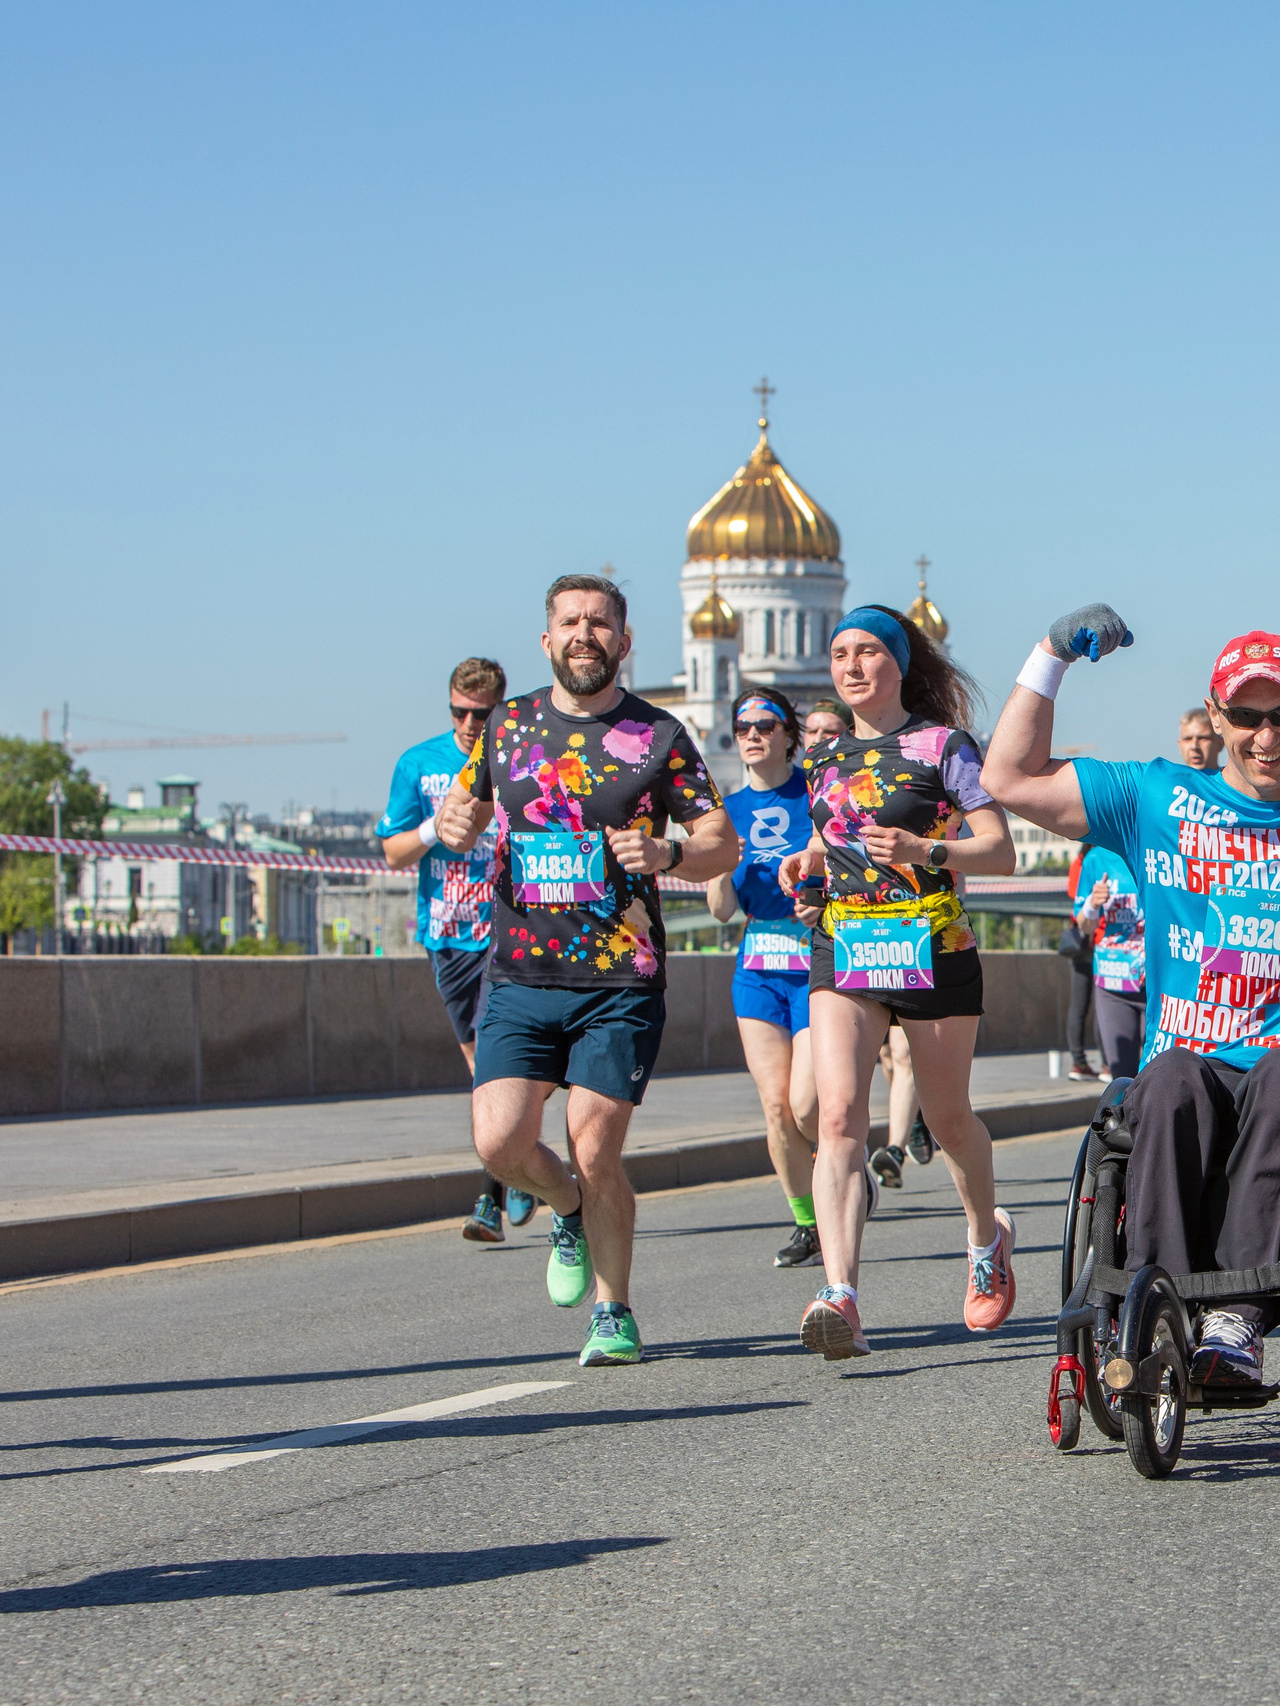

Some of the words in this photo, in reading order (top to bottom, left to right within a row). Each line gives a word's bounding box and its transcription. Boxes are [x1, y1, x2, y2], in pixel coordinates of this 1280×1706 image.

[1218, 649, 1241, 670] RUS
[1168, 785, 1239, 827] 2024
[526, 854, 586, 880] 34834
[1228, 889, 1247, 898] ПСБ
[852, 941, 914, 967] 35000
